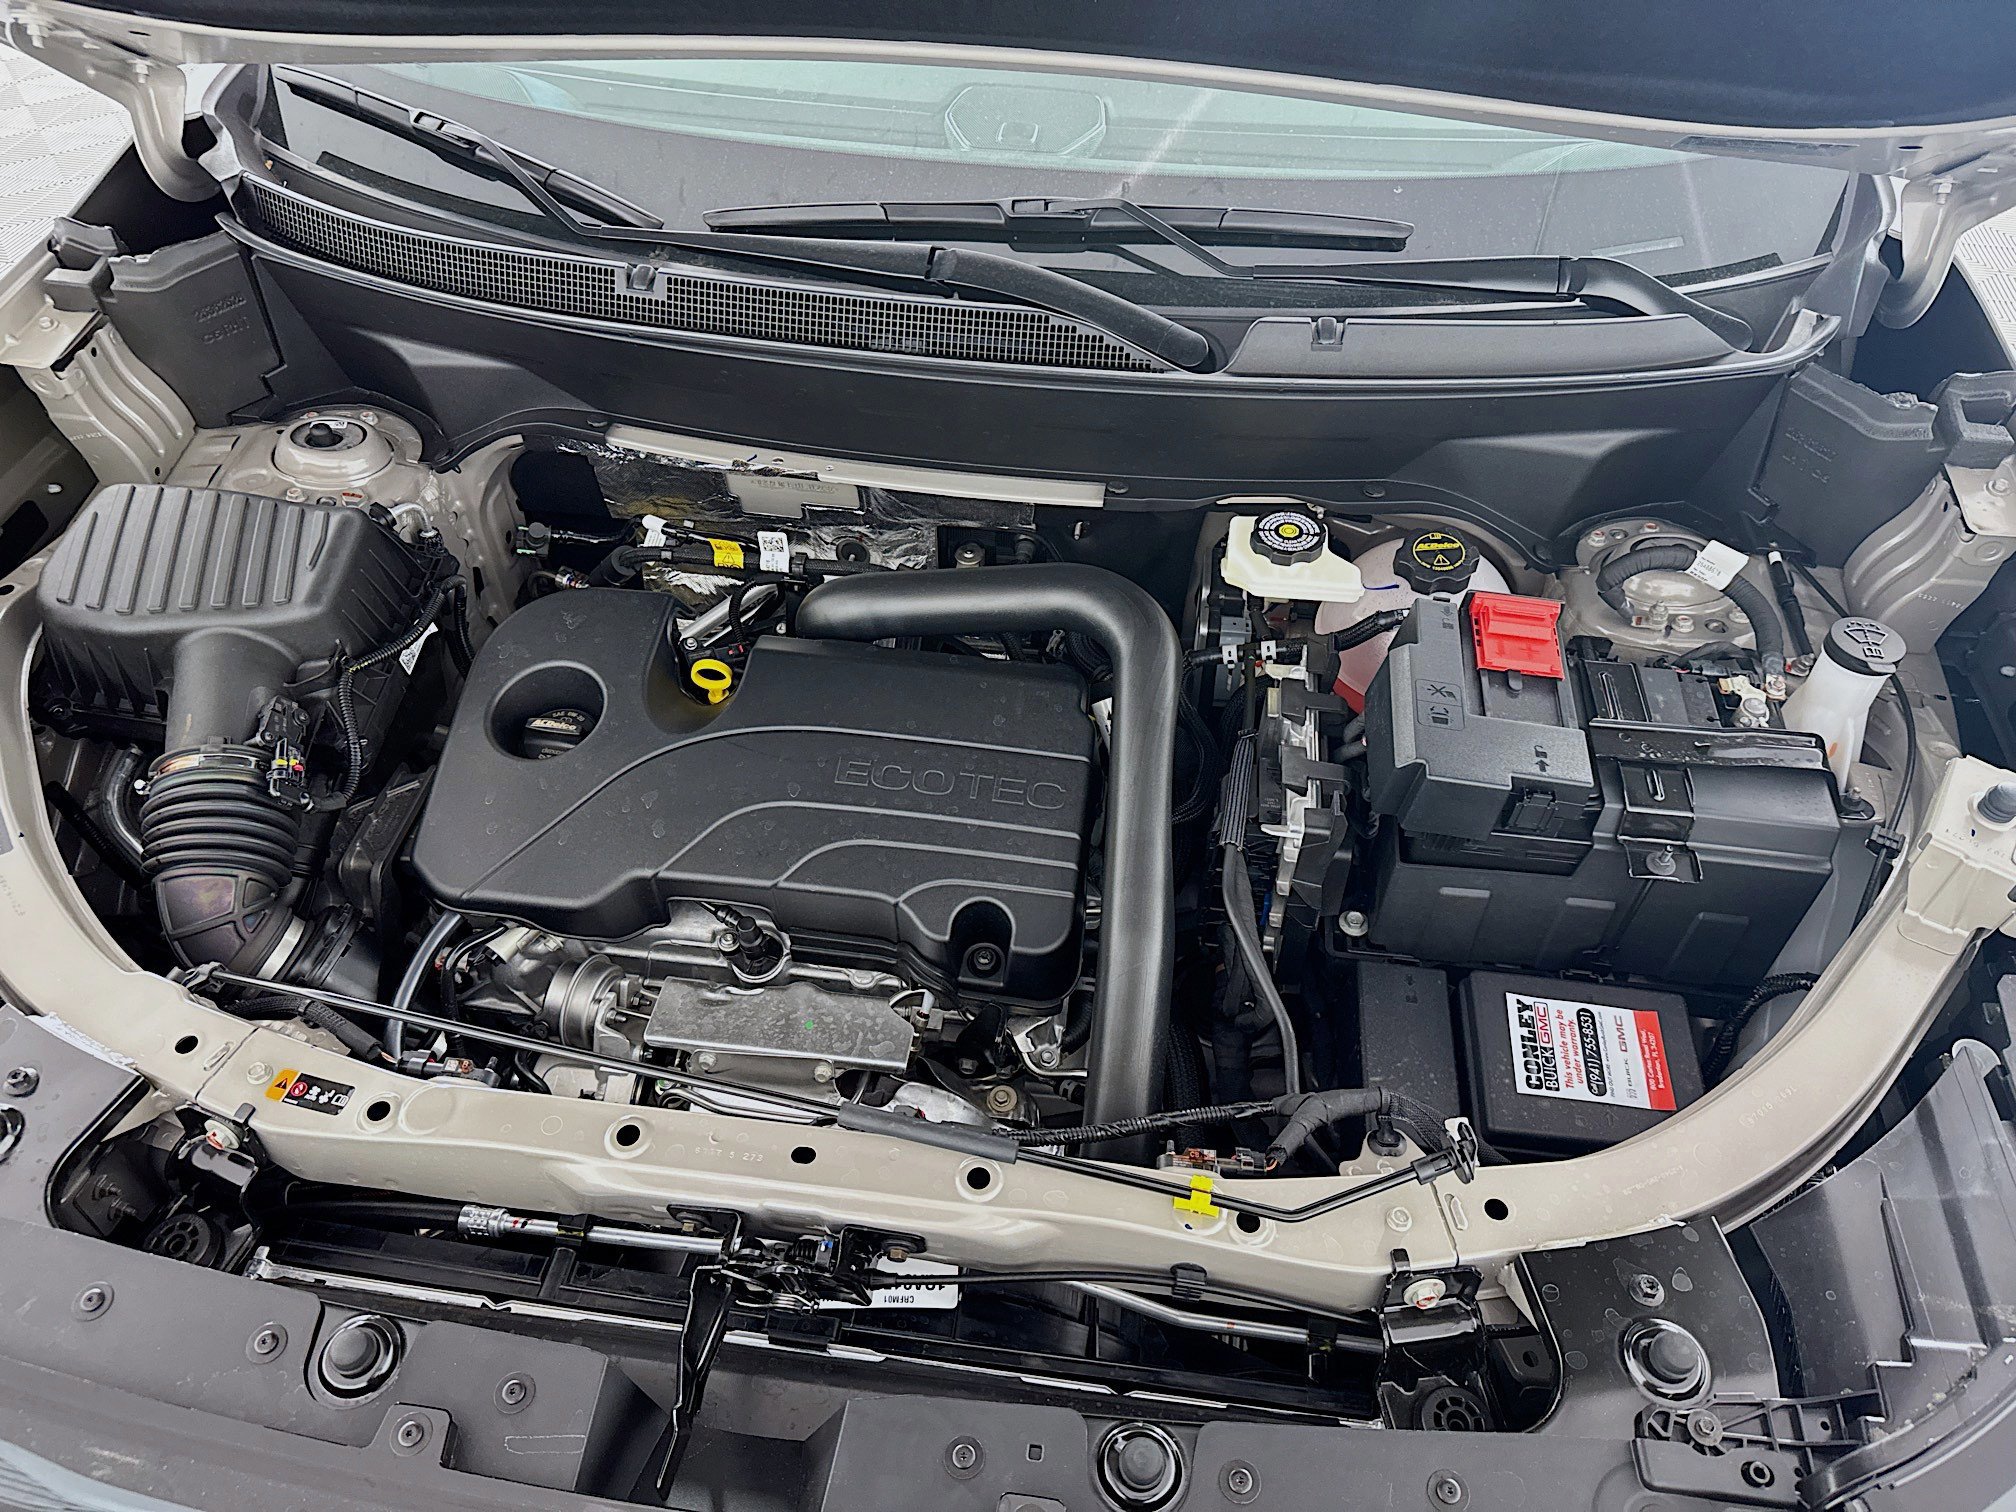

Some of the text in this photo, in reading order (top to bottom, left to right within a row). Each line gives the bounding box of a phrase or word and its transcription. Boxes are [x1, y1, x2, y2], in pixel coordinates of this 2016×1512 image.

[530, 719, 577, 730] ACDelco
[834, 756, 1067, 810] ECOTEC
[1516, 999, 1543, 1090] CONLEY
[1537, 1006, 1558, 1088] BUICK GMC
[1555, 1009, 1574, 1088] This vehicle may be
[1580, 1012, 1599, 1057] 755-8531
[1614, 1015, 1627, 1052] GMC
[1573, 1059, 1584, 1084] under
[1586, 1059, 1604, 1085] (941)
